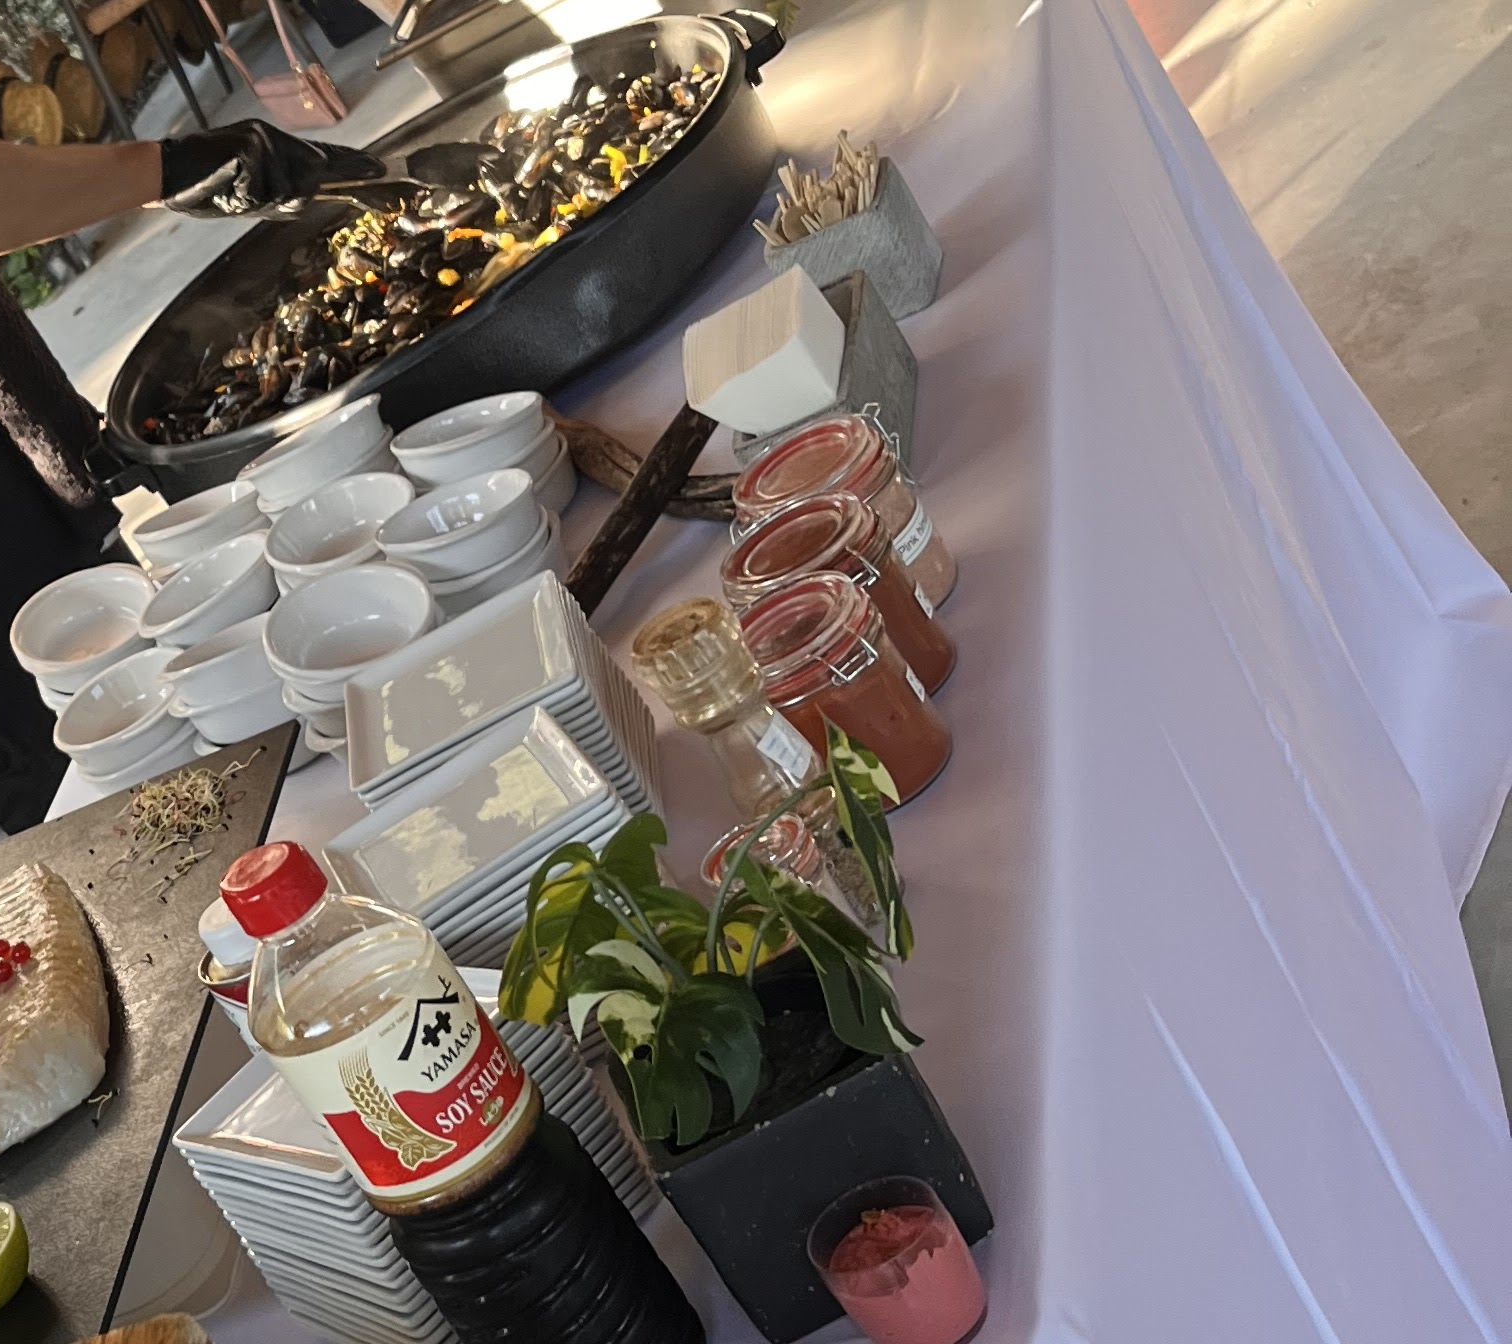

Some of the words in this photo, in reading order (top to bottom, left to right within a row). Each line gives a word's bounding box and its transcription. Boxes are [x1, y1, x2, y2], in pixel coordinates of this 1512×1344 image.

[420, 1020, 477, 1083] YAMASA
[435, 1092, 474, 1134] SOY
[469, 1046, 509, 1105] SAUCE
